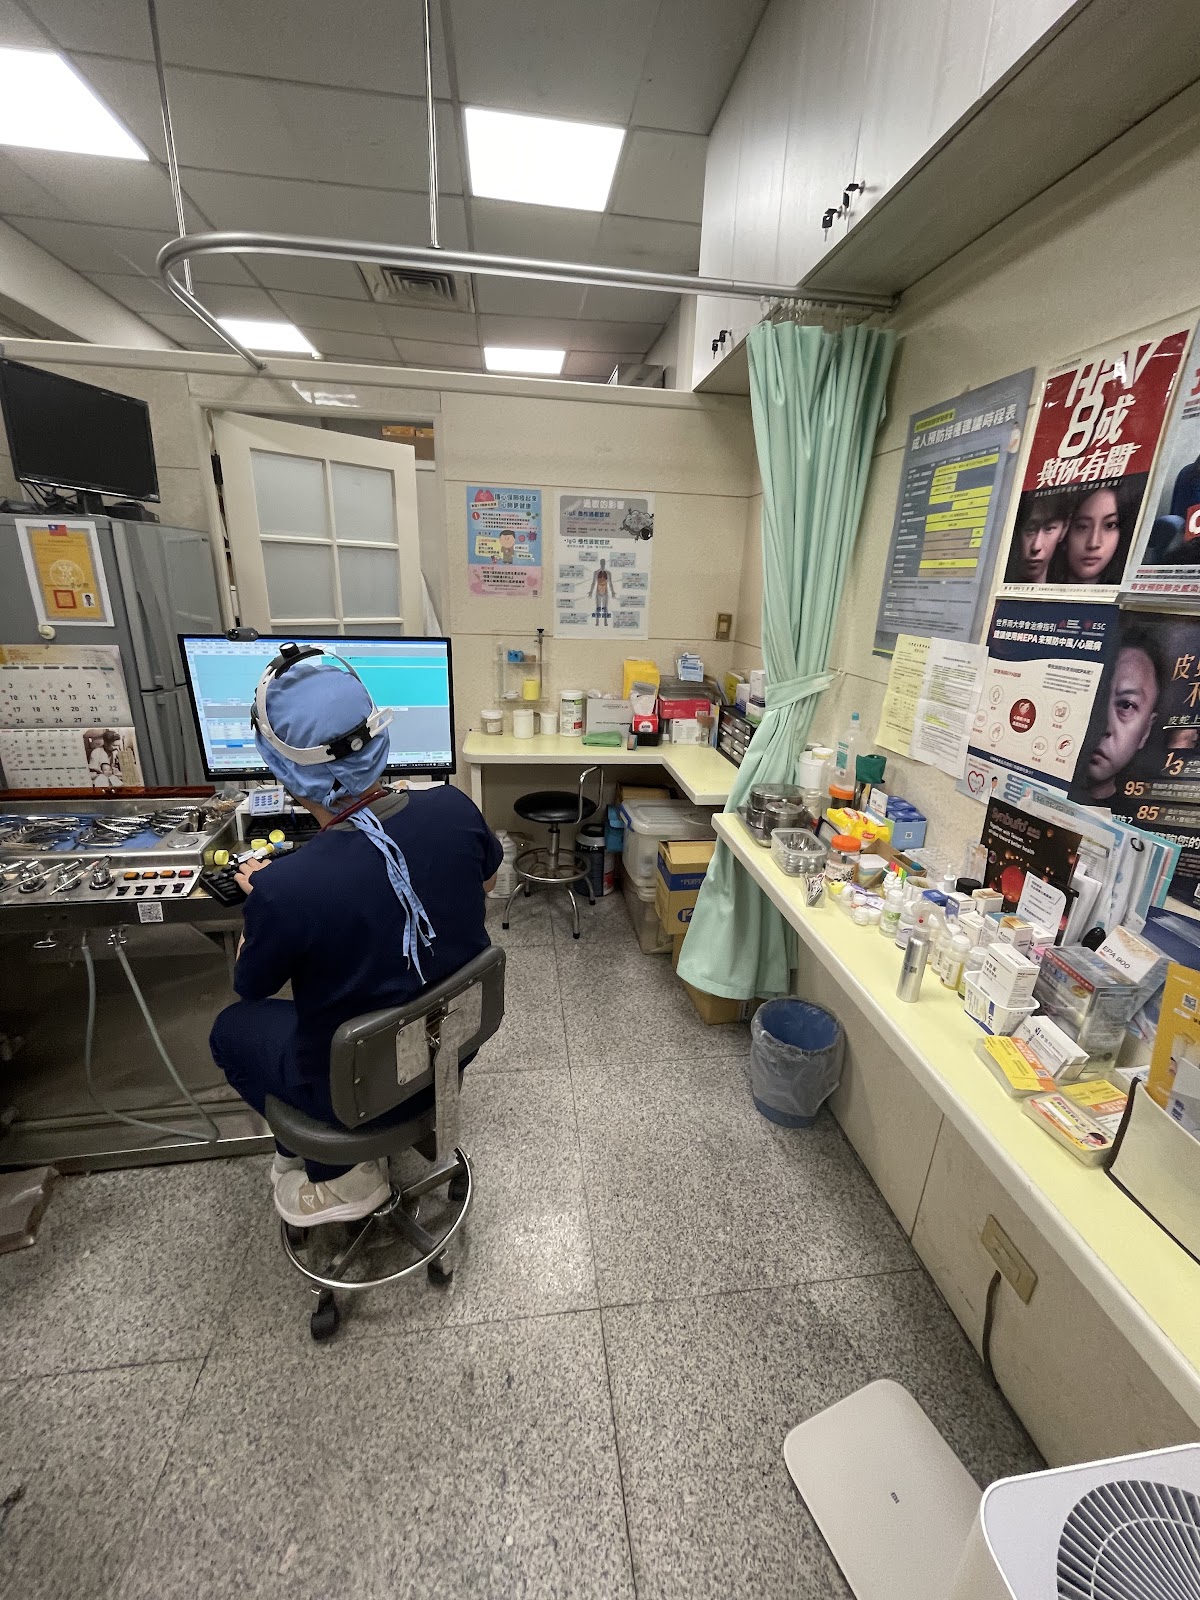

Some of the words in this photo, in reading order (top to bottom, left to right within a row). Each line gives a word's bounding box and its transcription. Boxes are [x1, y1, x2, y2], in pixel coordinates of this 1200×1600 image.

[911, 403, 1017, 451] 成人預防接種建議時程表
[1036, 442, 1142, 490] 與你有關
[1130, 583, 1200, 593] 有效預防肺炎感染
[996, 618, 1057, 633] 世界兩大學會治療指引
[1092, 622, 1107, 631] ESC
[1101, 945, 1117, 959] EPA
[1115, 956, 1132, 970] 900
